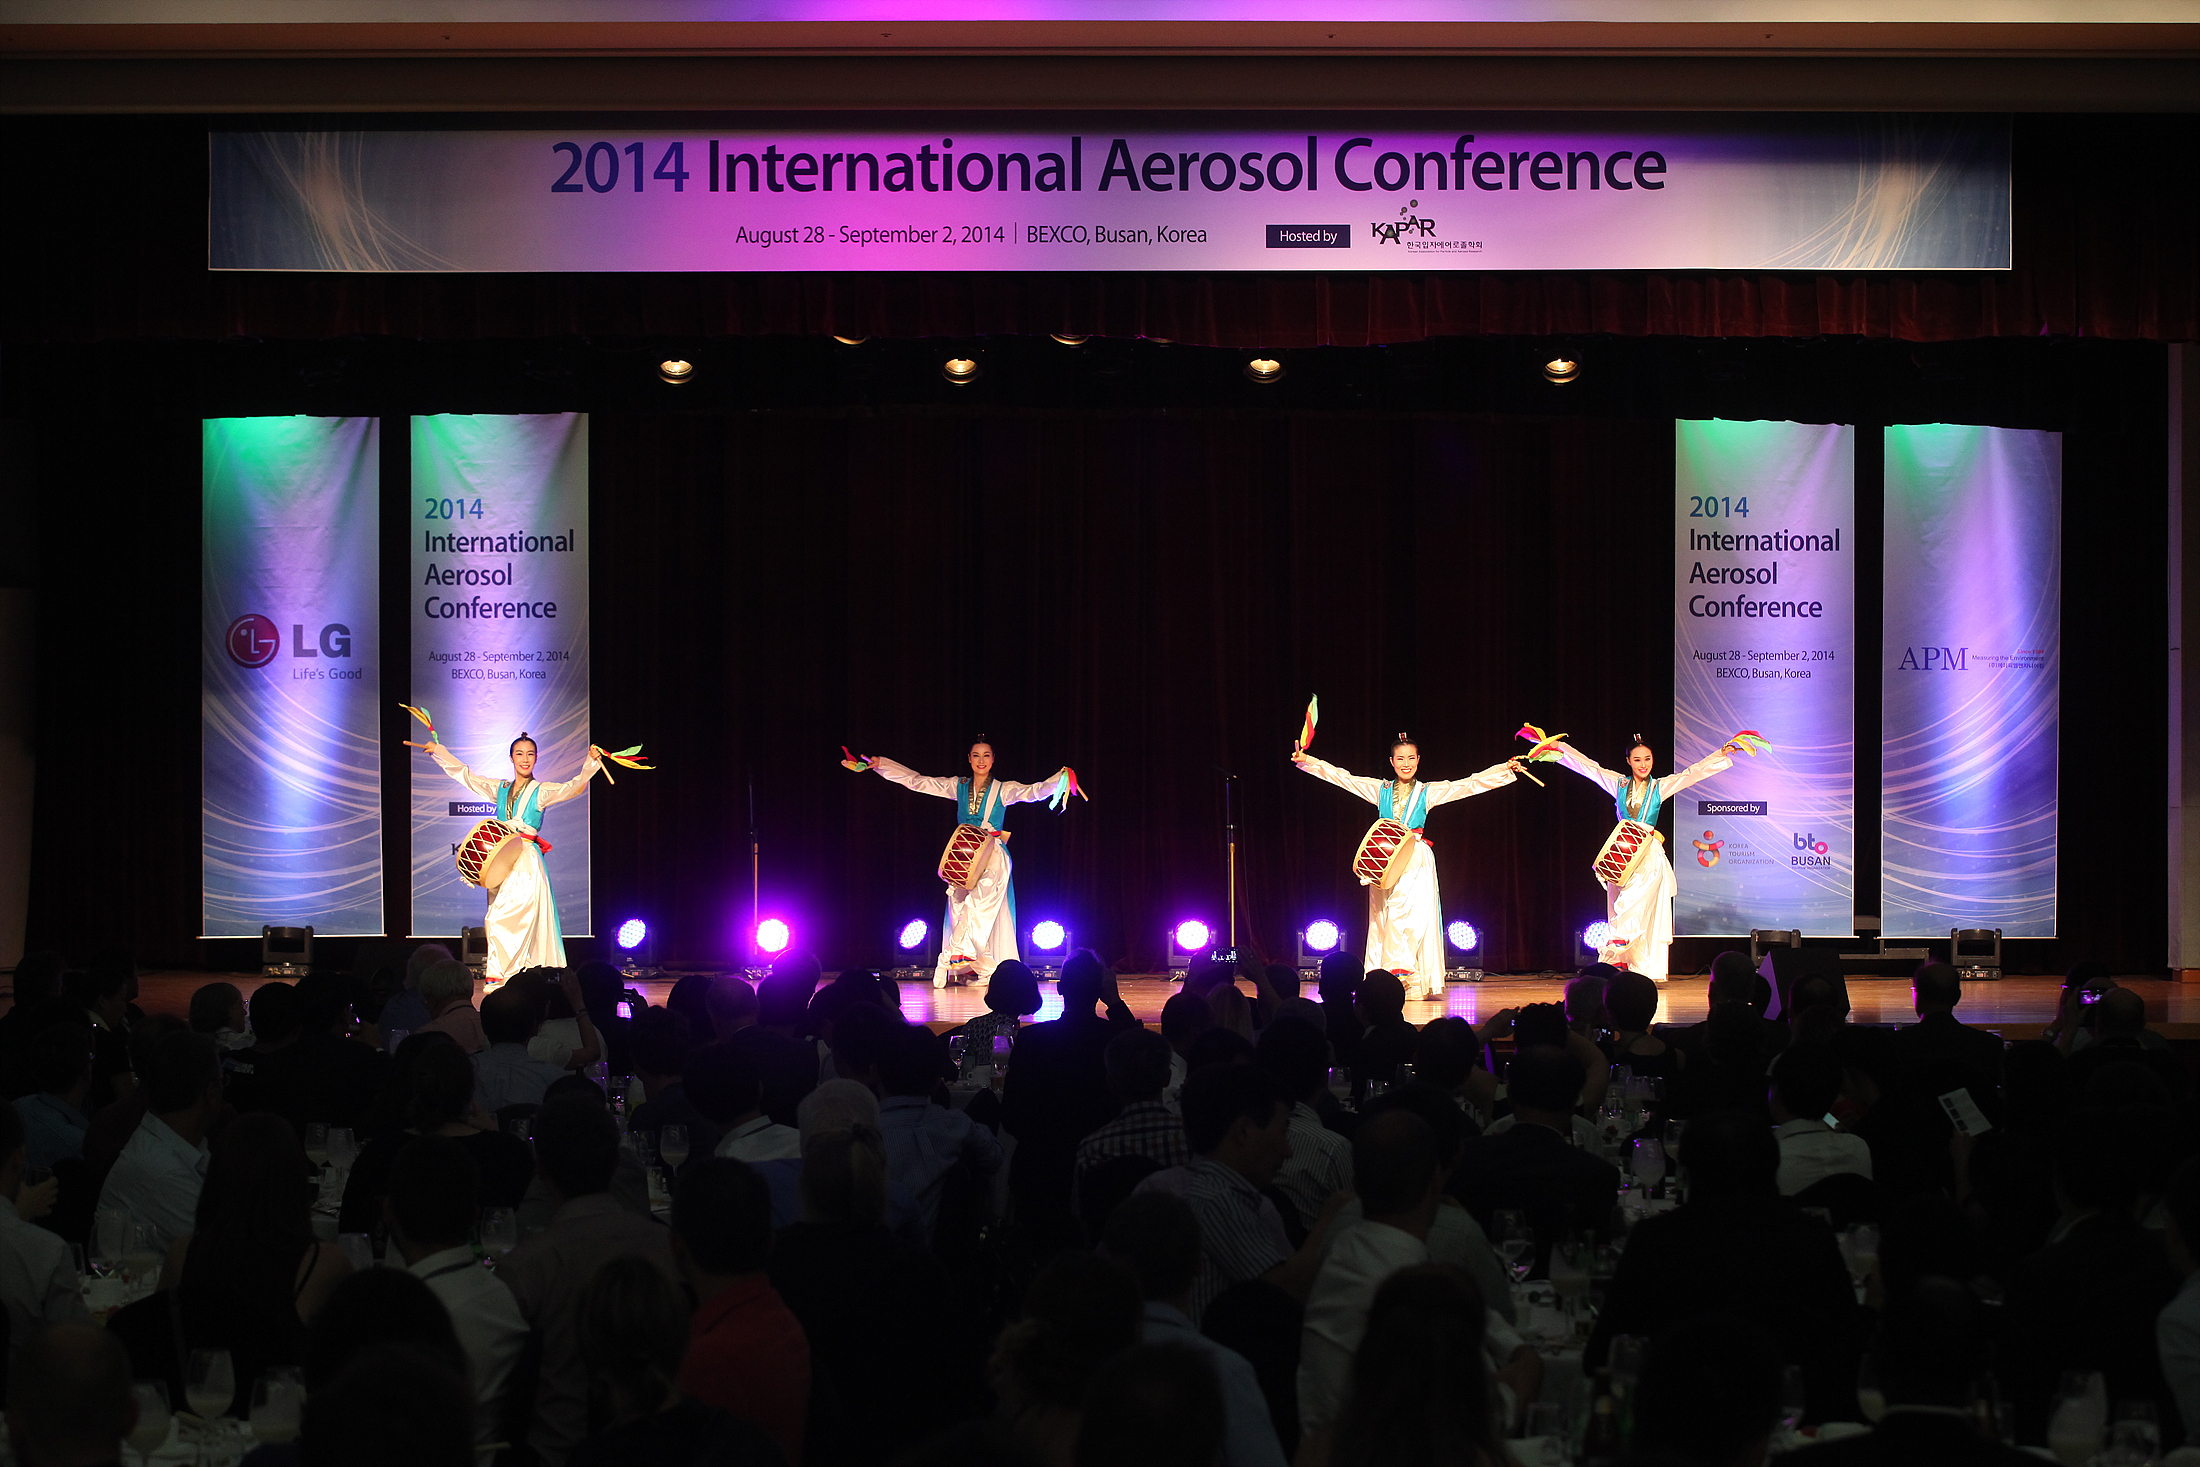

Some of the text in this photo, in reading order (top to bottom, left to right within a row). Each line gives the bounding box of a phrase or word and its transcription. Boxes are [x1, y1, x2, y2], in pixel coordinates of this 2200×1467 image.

[550, 135, 1667, 193] 2014 International Aerosol Conference
[735, 226, 800, 249] August
[802, 226, 825, 244] 28
[839, 225, 939, 248] September
[941, 226, 957, 247] 2,
[960, 226, 1006, 244] 2014
[1027, 226, 1091, 247] BEXCO,
[1095, 226, 1153, 247] Busan,
[1157, 226, 1207, 244] Korea
[1279, 229, 1338, 246] Hosted by
[1370, 215, 1437, 245] KAPAR
[424, 497, 485, 520] 2014
[1689, 495, 1750, 519] 2014
[425, 529, 574, 553] International
[1690, 528, 1840, 552] International
[424, 562, 512, 586] Aerosol
[1688, 561, 1778, 585] Aerosol
[424, 595, 557, 619] Conference
[1688, 594, 1823, 618] Conference
[292, 623, 351, 658] LG
[428, 650, 463, 664] August
[464, 650, 476, 662] 28
[483, 650, 534, 664] September
[536, 651, 545, 663] 2,
[546, 650, 570, 662] 2014
[1692, 649, 1727, 663] August
[1728, 649, 1741, 661] 28
[1747, 649, 1801, 663] September
[1802, 650, 1810, 662] 2,
[1811, 650, 1835, 661] 2014
[1898, 646, 1969, 671] APM
[292, 667, 362, 680] Life's Good
[451, 668, 547, 681] BEXCO, Busan, Korea
[1716, 667, 1812, 680] BEXCO, Busan, Korea
[457, 803, 497, 815] Hosted by
[1706, 803, 1761, 814] Sponsored by
[1793, 832, 1829, 855] bto
[1791, 856, 1831, 866] BUSAN
